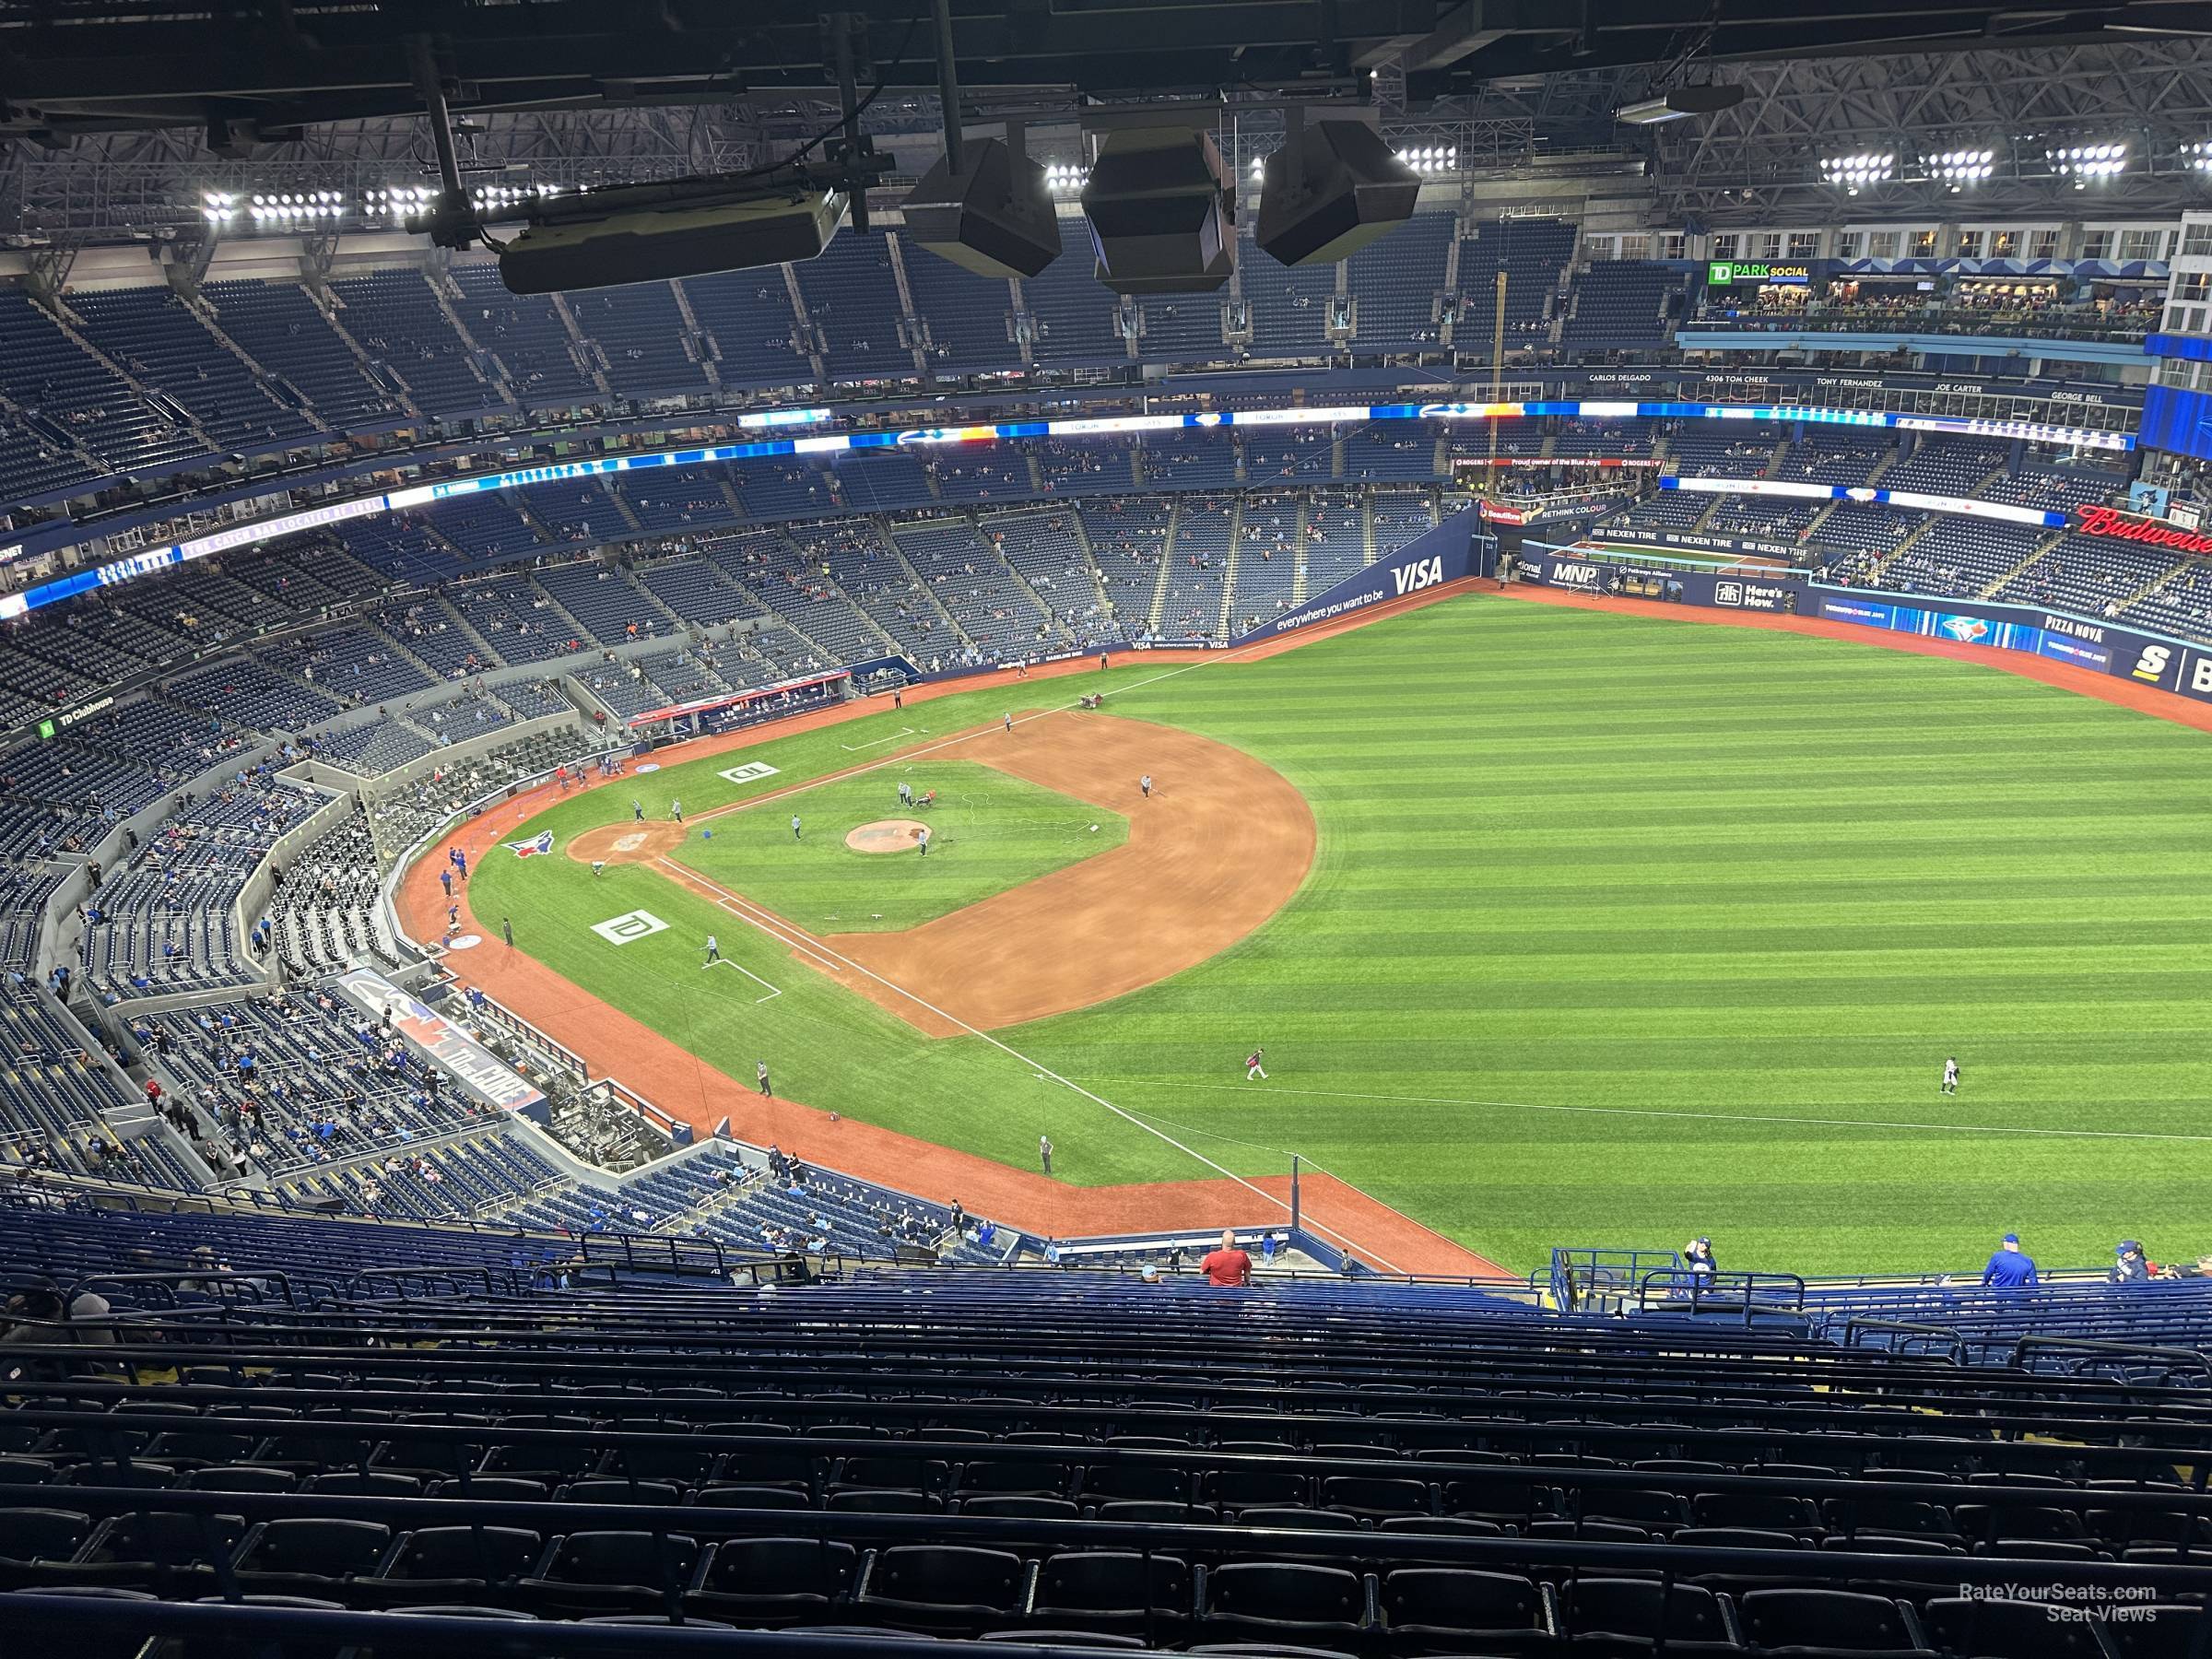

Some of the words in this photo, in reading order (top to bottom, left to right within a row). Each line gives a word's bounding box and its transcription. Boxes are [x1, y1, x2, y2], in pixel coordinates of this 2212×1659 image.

[1712, 265, 1731, 281] TD
[1733, 264, 1770, 276] PARK
[1770, 266, 1809, 276] SOCIAL
[1817, 377, 1838, 385] TONY
[1839, 379, 1883, 388] FERNANDEZ
[1935, 382, 1950, 392] JOE
[1953, 384, 1982, 394] CARTER
[2052, 392, 2082, 402] GEORGE
[2085, 394, 2102, 403] BELL
[1542, 507, 1574, 519] RETHINK
[1575, 504, 1606, 514] COLOUR
[187, 542, 211, 555] THE
[215, 530, 251, 548] CATCH
[255, 523, 277, 537] BAR
[282, 510, 331, 530] LOCATED
[1606, 529, 1636, 538] NEXEN
[1637, 531, 1657, 540] TIRE
[1681, 535, 1711, 546] NEXEN
[1712, 539, 1732, 547] TIRE
[1757, 543, 1787, 555] NEXEN
[1390, 556, 1442, 595] VISA
[1553, 562, 1598, 583] MNP
[1745, 585, 1783, 598] Here's
[1744, 595, 1774, 608] How.
[1277, 606, 1326, 630] everywhere
[1326, 602, 1343, 617] you
[1343, 595, 1363, 610] want
[1363, 594, 1373, 605] to
[1373, 590, 1383, 600] be
[2044, 615, 2074, 636] PIZZA
[2075, 623, 2103, 643] NOVA
[1131, 641, 1151, 650] VISA
[2136, 644, 2171, 675] S
[59, 714, 73, 726] TD
[72, 696, 114, 720] Clubhouse
[729, 766, 772, 780] TD
[609, 913, 653, 937] TD
[468, 1065, 535, 1106] CORE
